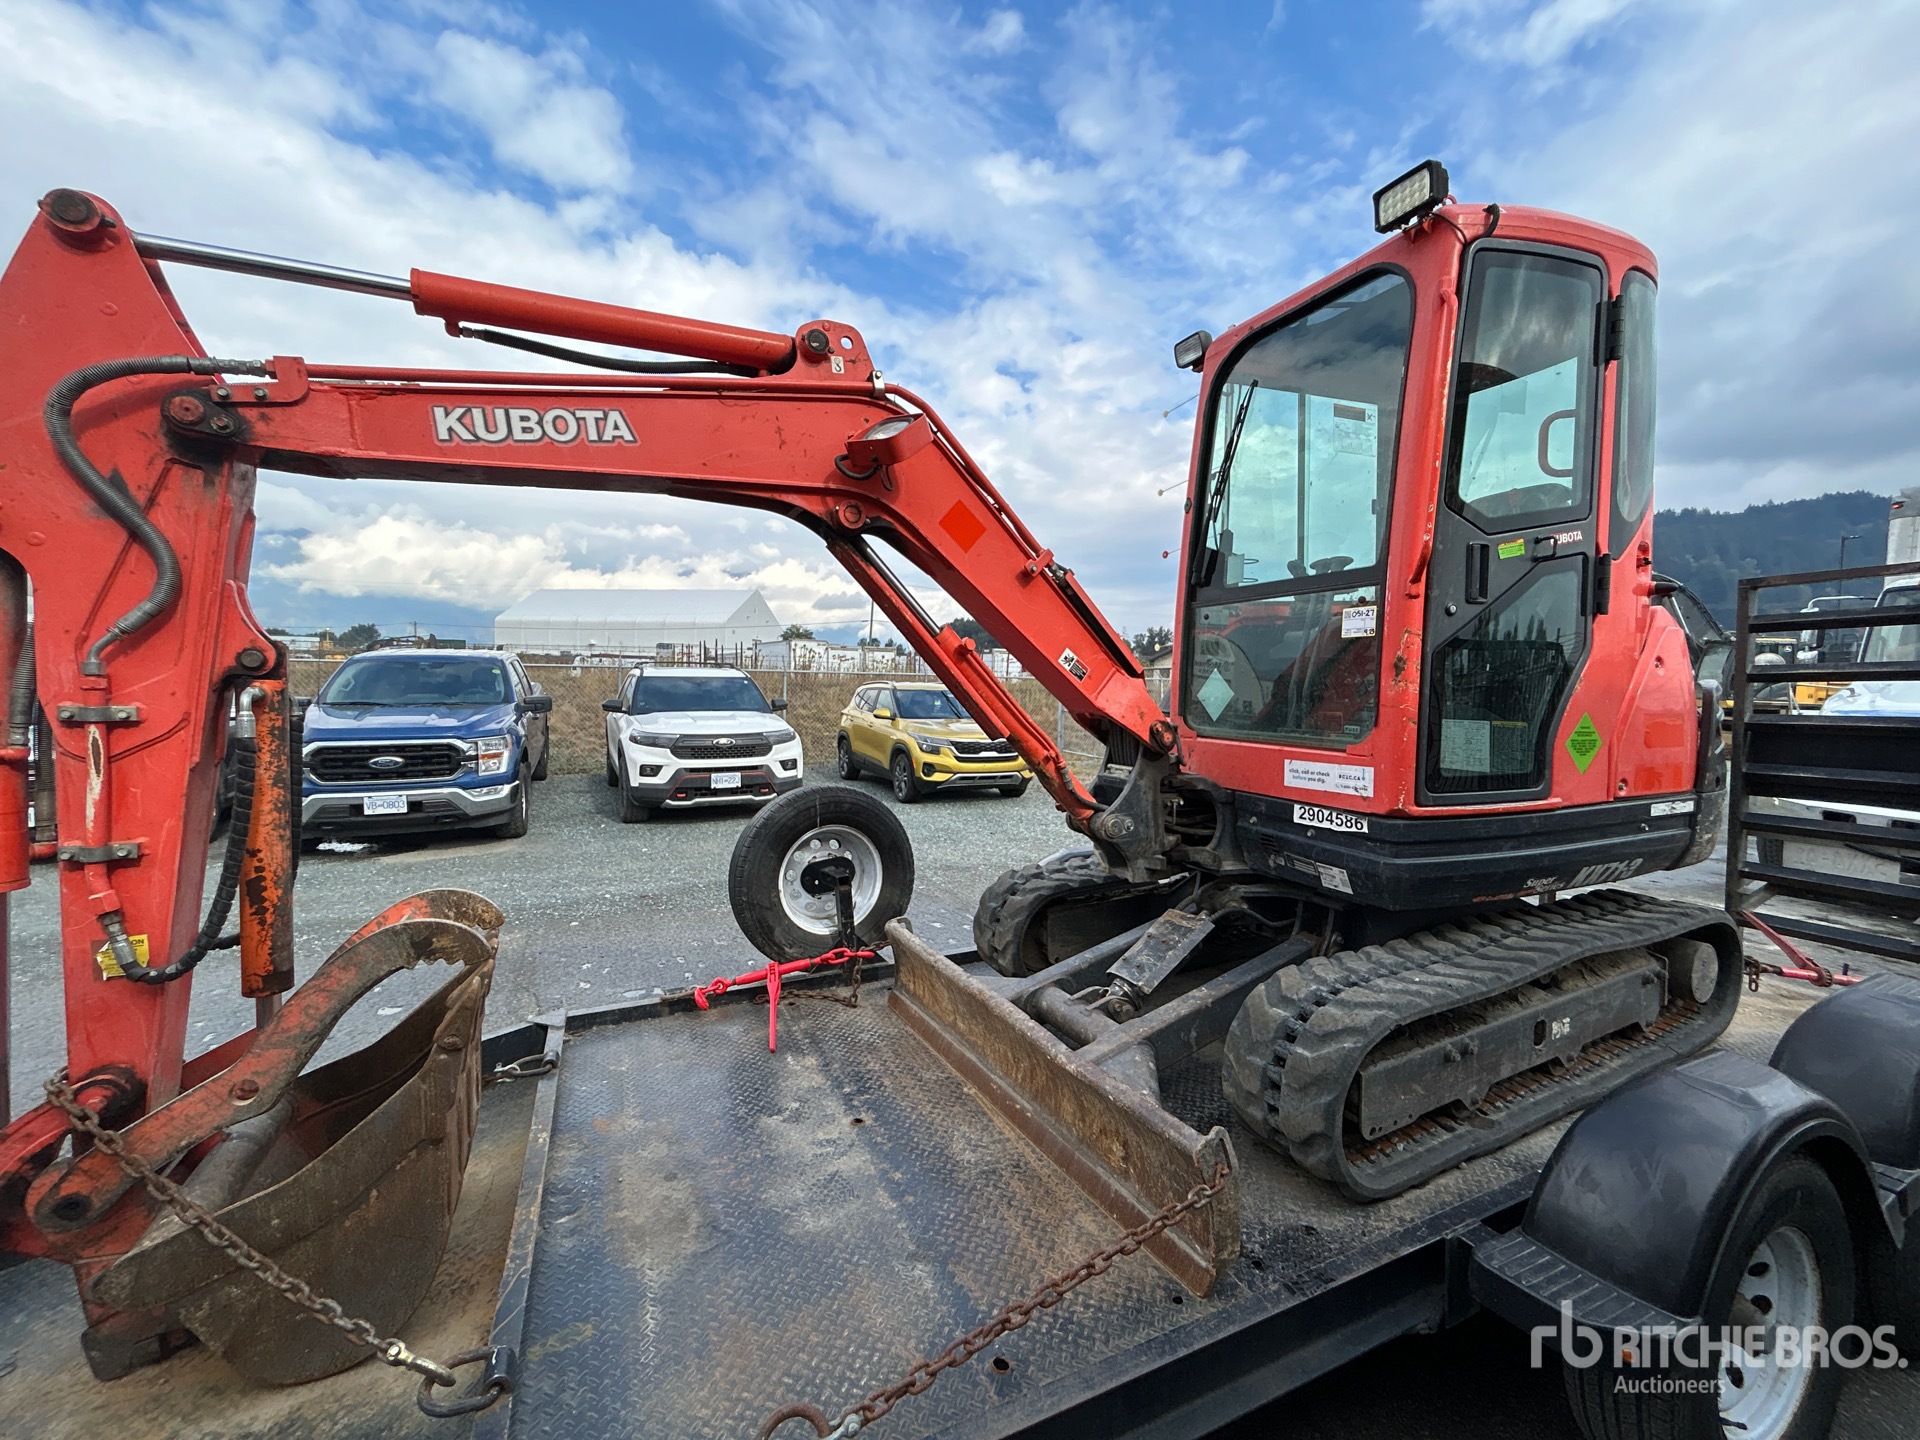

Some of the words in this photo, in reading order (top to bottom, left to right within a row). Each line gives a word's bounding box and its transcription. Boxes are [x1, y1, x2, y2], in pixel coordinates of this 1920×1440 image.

[432, 406, 638, 442] KUBOTA
[1298, 805, 1364, 831] 2904586
[1523, 875, 1559, 888] Super
